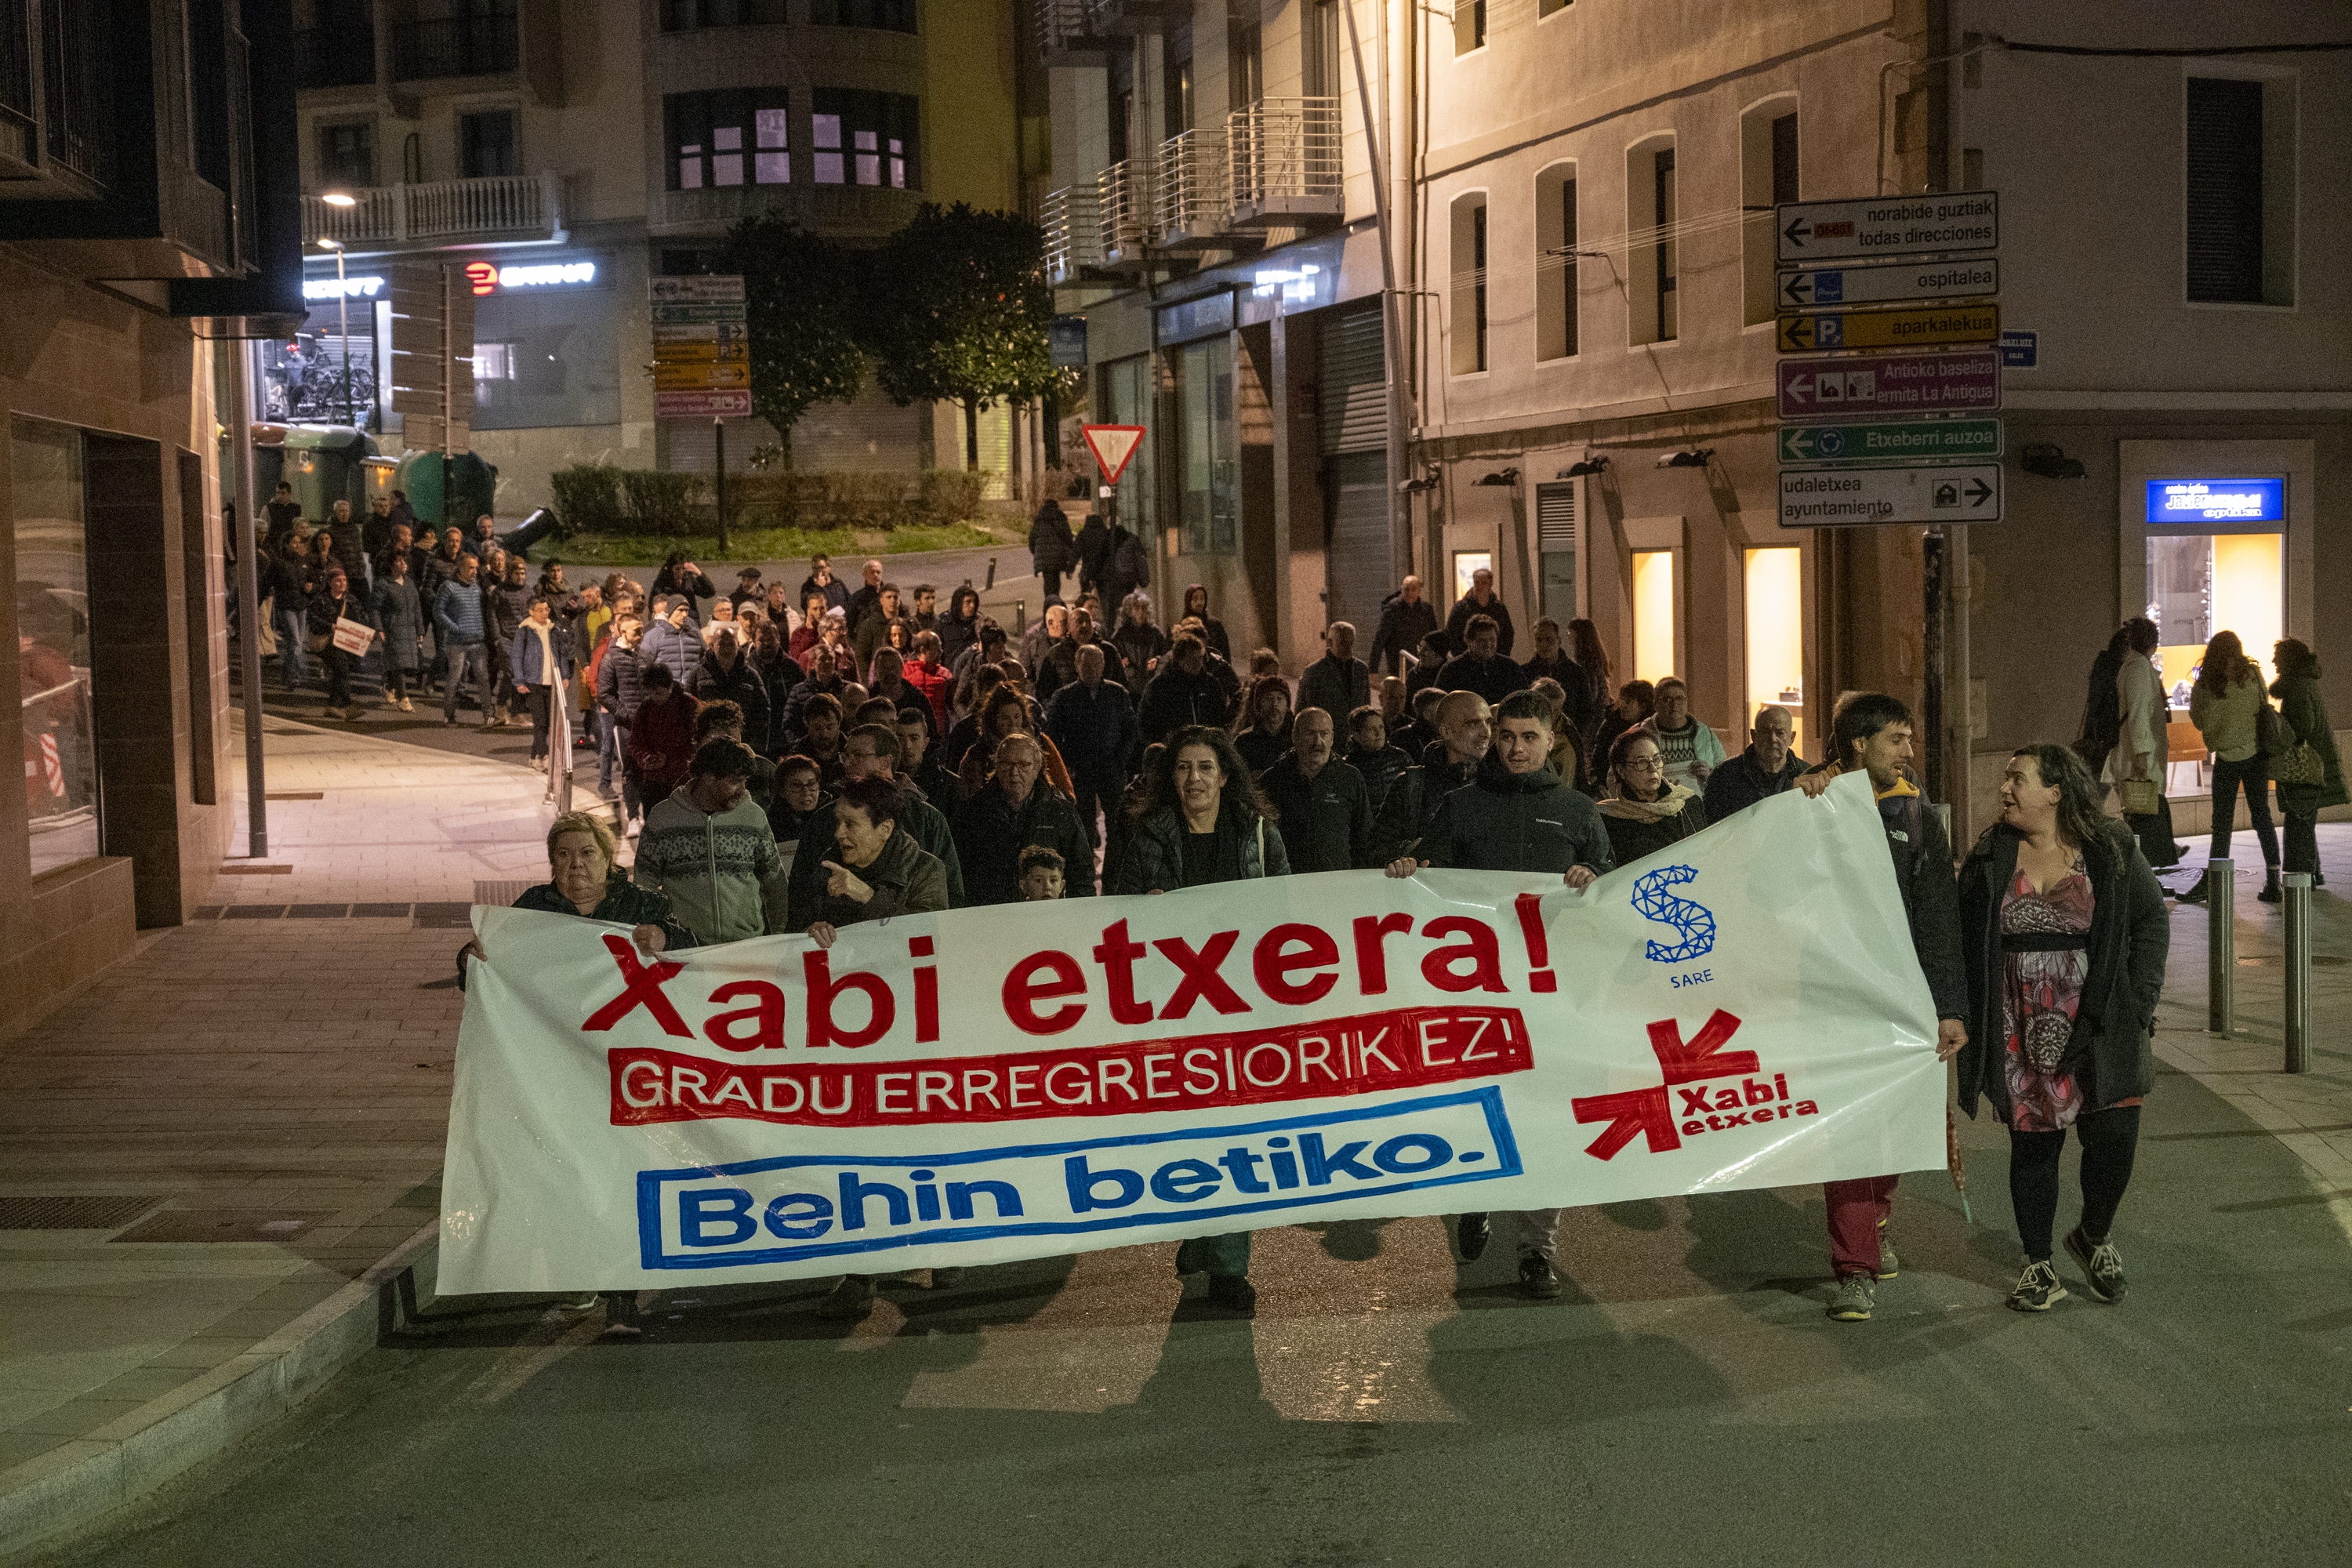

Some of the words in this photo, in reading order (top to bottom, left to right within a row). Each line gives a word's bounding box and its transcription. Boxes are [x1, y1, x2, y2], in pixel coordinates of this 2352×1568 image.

[1867, 203, 1933, 222] norabide
[1937, 198, 1992, 221] guztiak
[1859, 230, 1900, 246] todas
[1904, 225, 1991, 243] direcciones
[1918, 269, 1992, 289] ospitalea
[1820, 320, 1837, 343] P
[1892, 315, 1992, 337] aparkalekua
[1884, 361, 1935, 379] Antioko
[1939, 358, 1993, 376] baseliza
[1877, 386, 1918, 403] ermita
[1922, 385, 1939, 401] La
[1942, 383, 1993, 402] Antigua
[1866, 430, 1940, 448] Etxeberri
[1944, 430, 1993, 445] auzoa
[1784, 477, 1861, 493] udaletxea
[1784, 499, 1893, 519] ayuntamiento
[581, 934, 942, 1052] Xabi
[1001, 892, 1559, 1036] etxera!
[1670, 968, 1715, 989] SARE
[620, 1060, 853, 1116] GRADU
[876, 1026, 1399, 1114] ERREGRESIORIK
[1418, 1016, 1518, 1067] EZ!
[1677, 1073, 1790, 1117] Xabi
[1681, 1099, 1819, 1137] etxera
[678, 1168, 1024, 1248] Behin
[1064, 1132, 1486, 1214] betiko.
